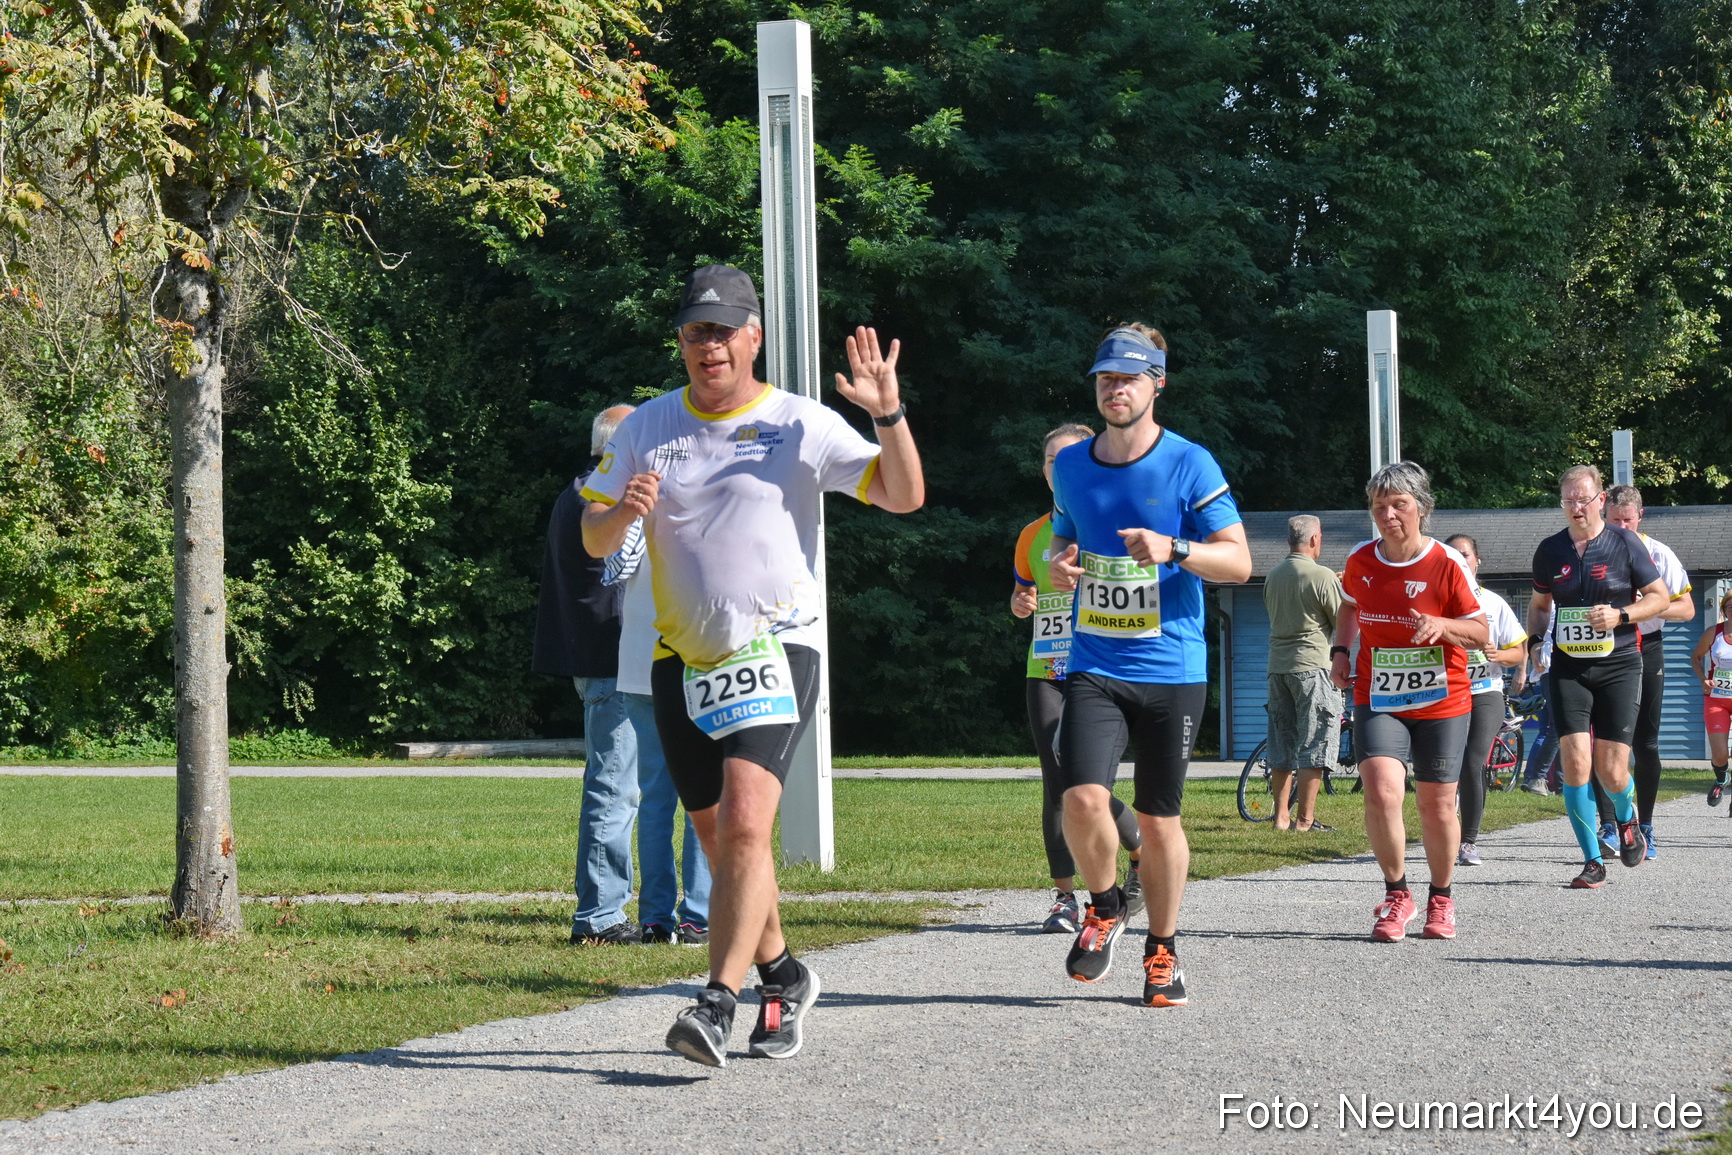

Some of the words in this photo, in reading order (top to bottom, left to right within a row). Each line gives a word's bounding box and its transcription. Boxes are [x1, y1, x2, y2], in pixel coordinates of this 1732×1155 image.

[737, 428, 758, 440] 20
[1085, 556, 1148, 577] BOCK
[1087, 582, 1145, 610] 1301
[1088, 614, 1146, 628] ANDREAS
[1376, 652, 1437, 666] BOCK
[696, 664, 780, 710] 2296
[1378, 670, 1438, 692] 2782
[1716, 680, 1732, 690] 22
[1389, 690, 1438, 705] CHRISTINE
[712, 700, 774, 727] ULRICH
[1183, 716, 1193, 745] cep
